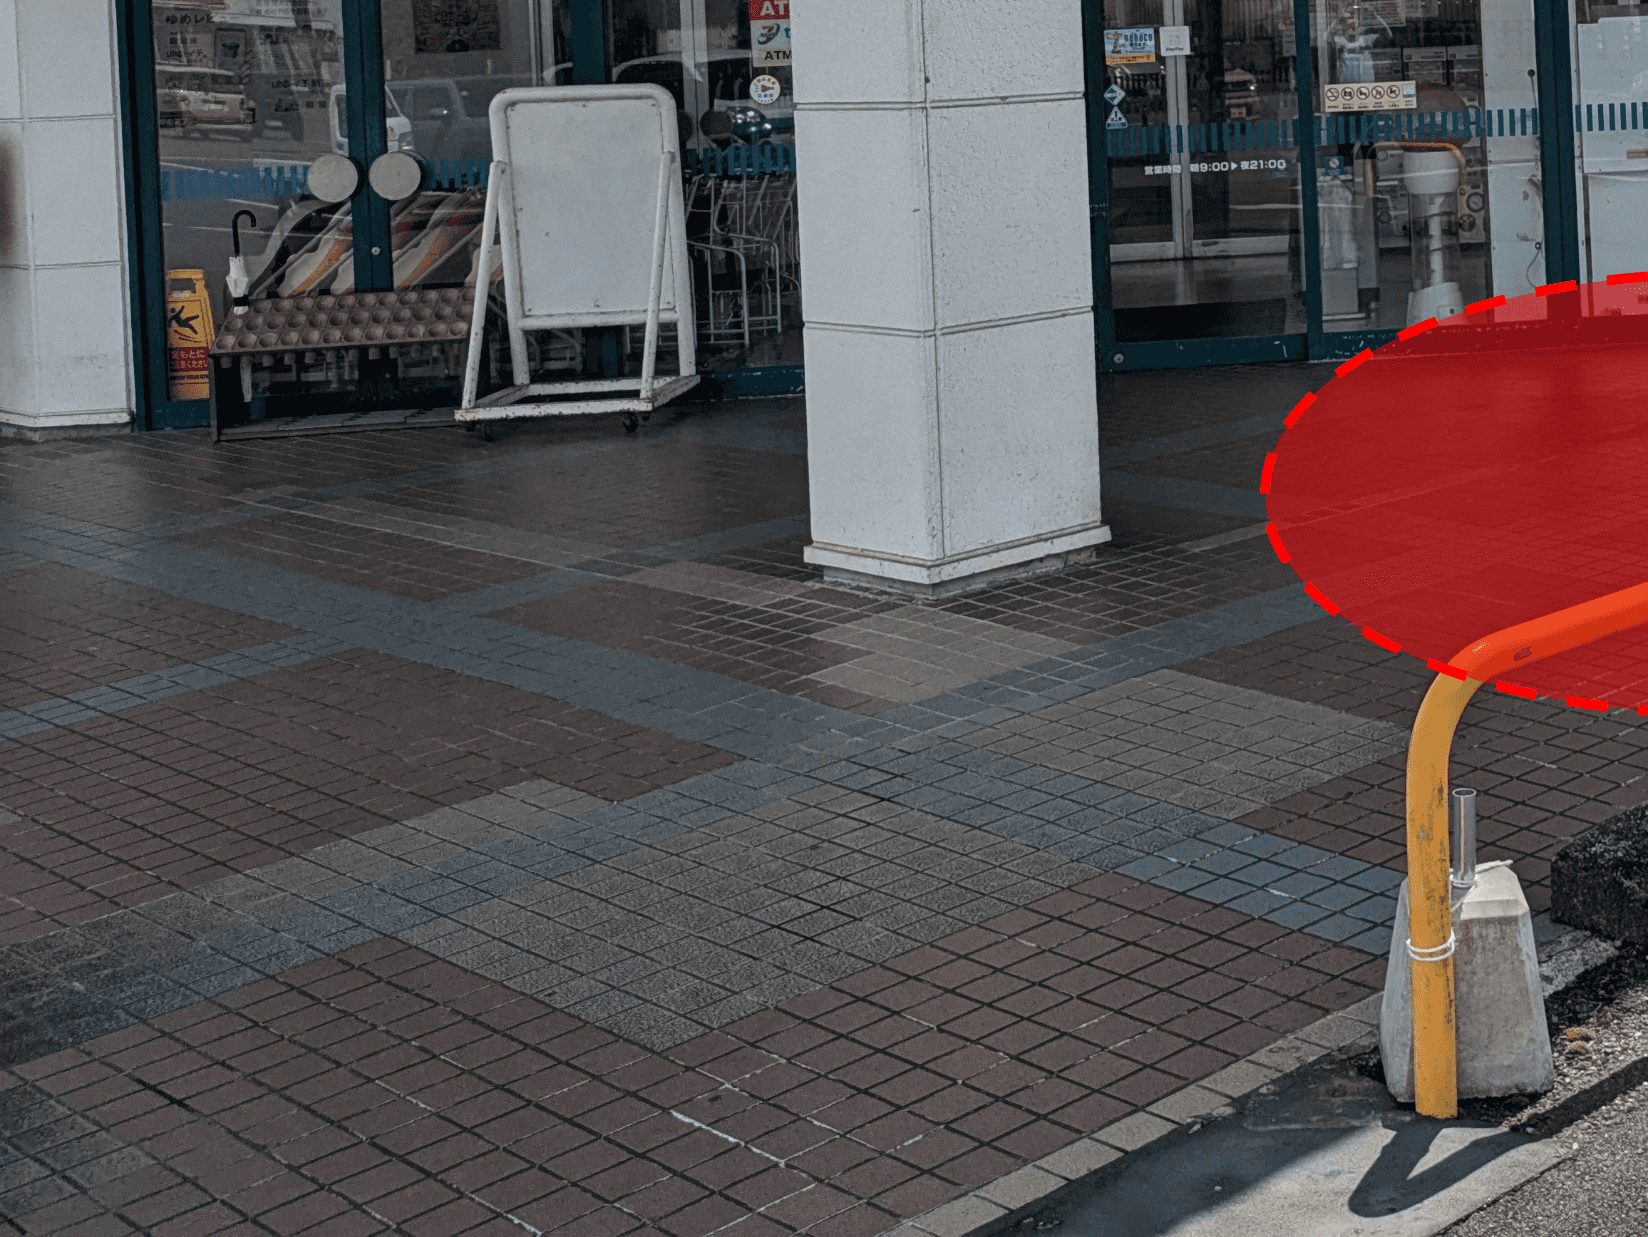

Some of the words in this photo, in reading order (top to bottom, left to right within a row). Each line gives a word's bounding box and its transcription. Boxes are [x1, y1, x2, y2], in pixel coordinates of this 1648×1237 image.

[760, 0, 788, 15] AT
[1144, 164, 1182, 175] 営業時間
